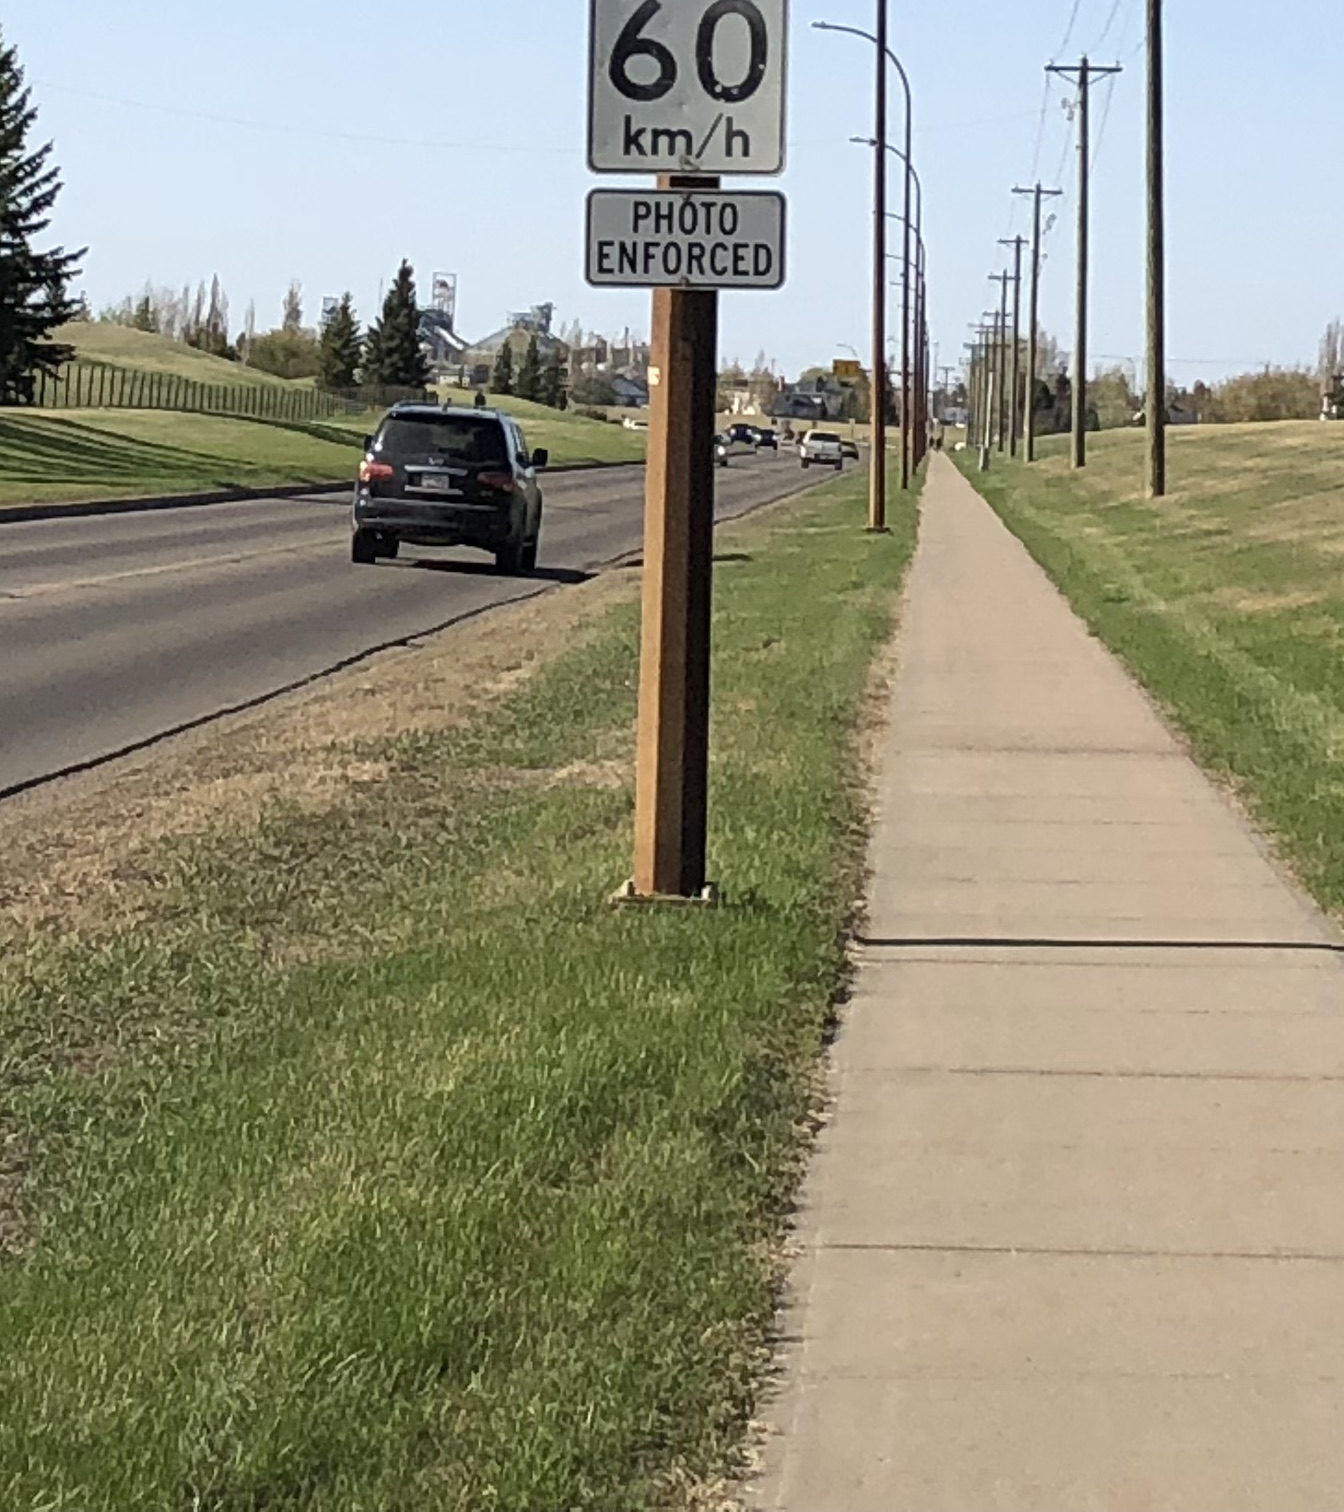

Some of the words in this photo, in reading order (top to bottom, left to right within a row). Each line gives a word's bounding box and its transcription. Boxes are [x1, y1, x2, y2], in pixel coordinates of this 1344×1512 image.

[622, 113, 750, 159] km/h
[632, 200, 738, 236] PHOTO
[596, 240, 773, 277] ENFORCED
